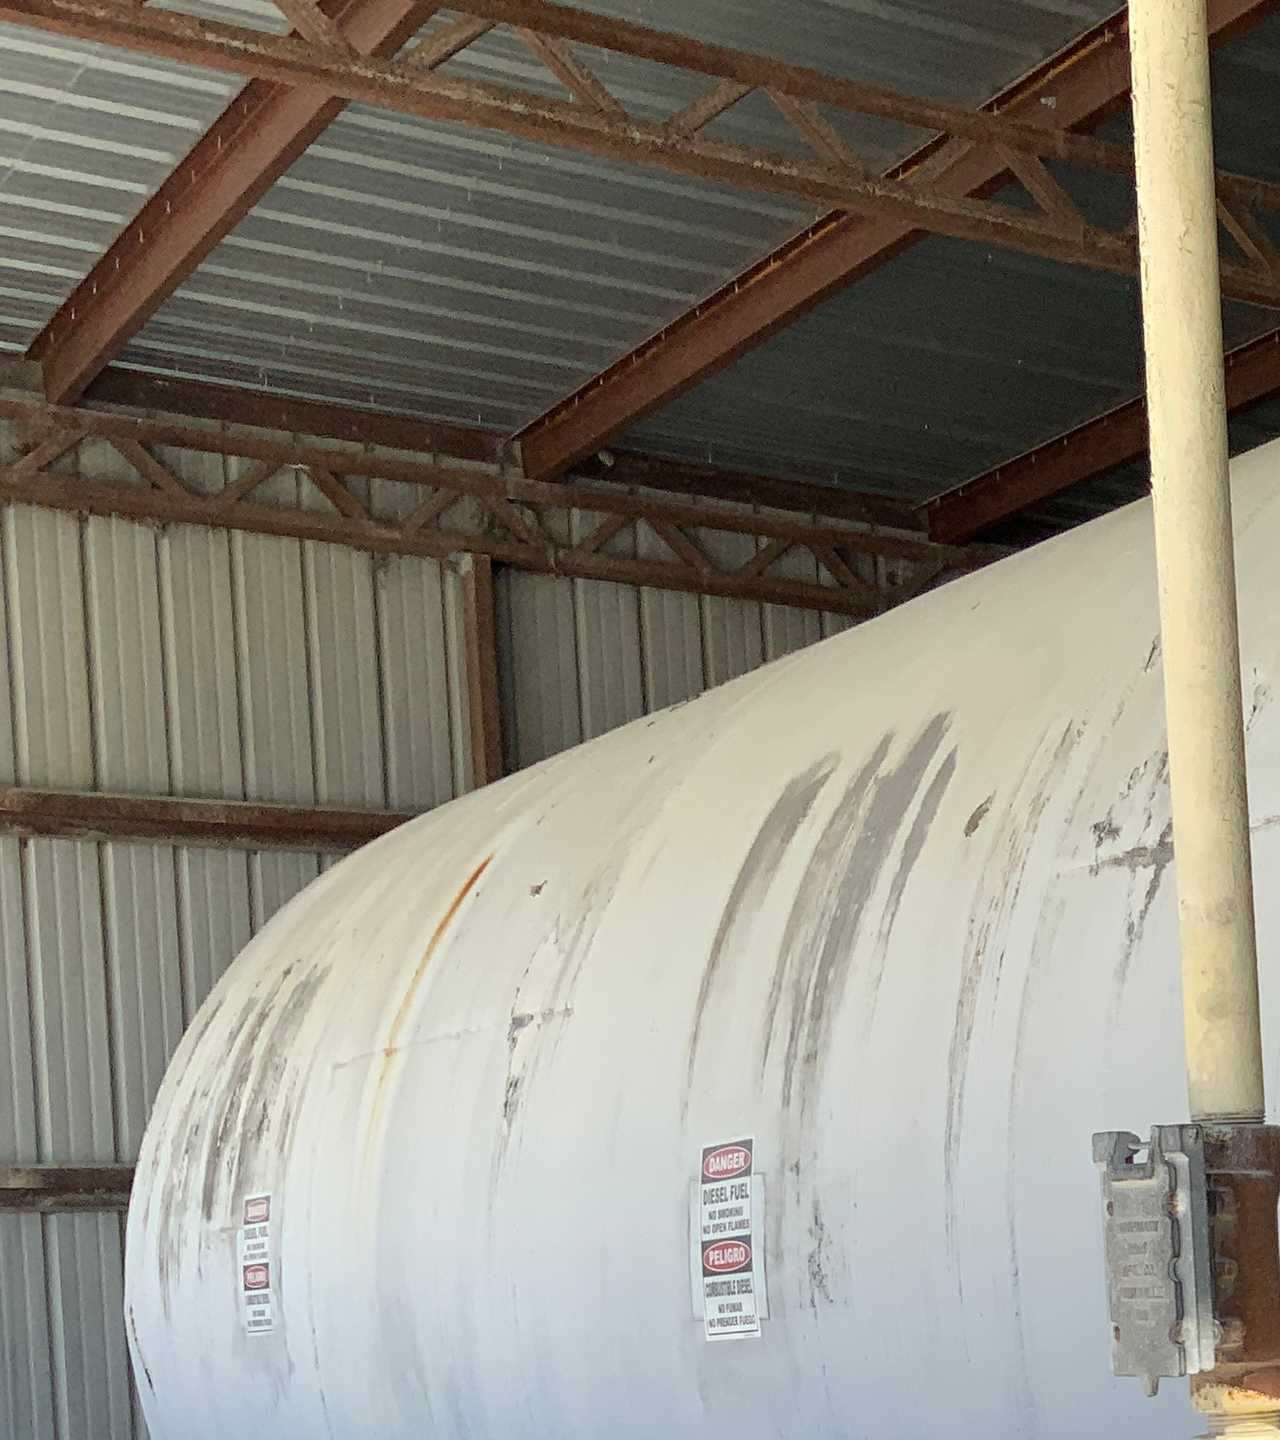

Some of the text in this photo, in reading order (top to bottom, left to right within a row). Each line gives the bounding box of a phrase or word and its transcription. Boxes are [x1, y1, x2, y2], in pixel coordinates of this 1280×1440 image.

[708, 1151, 745, 1173] DANGER
[703, 1182, 749, 1205] DIESEL FUEL
[709, 1247, 746, 1265] PELIGRO
